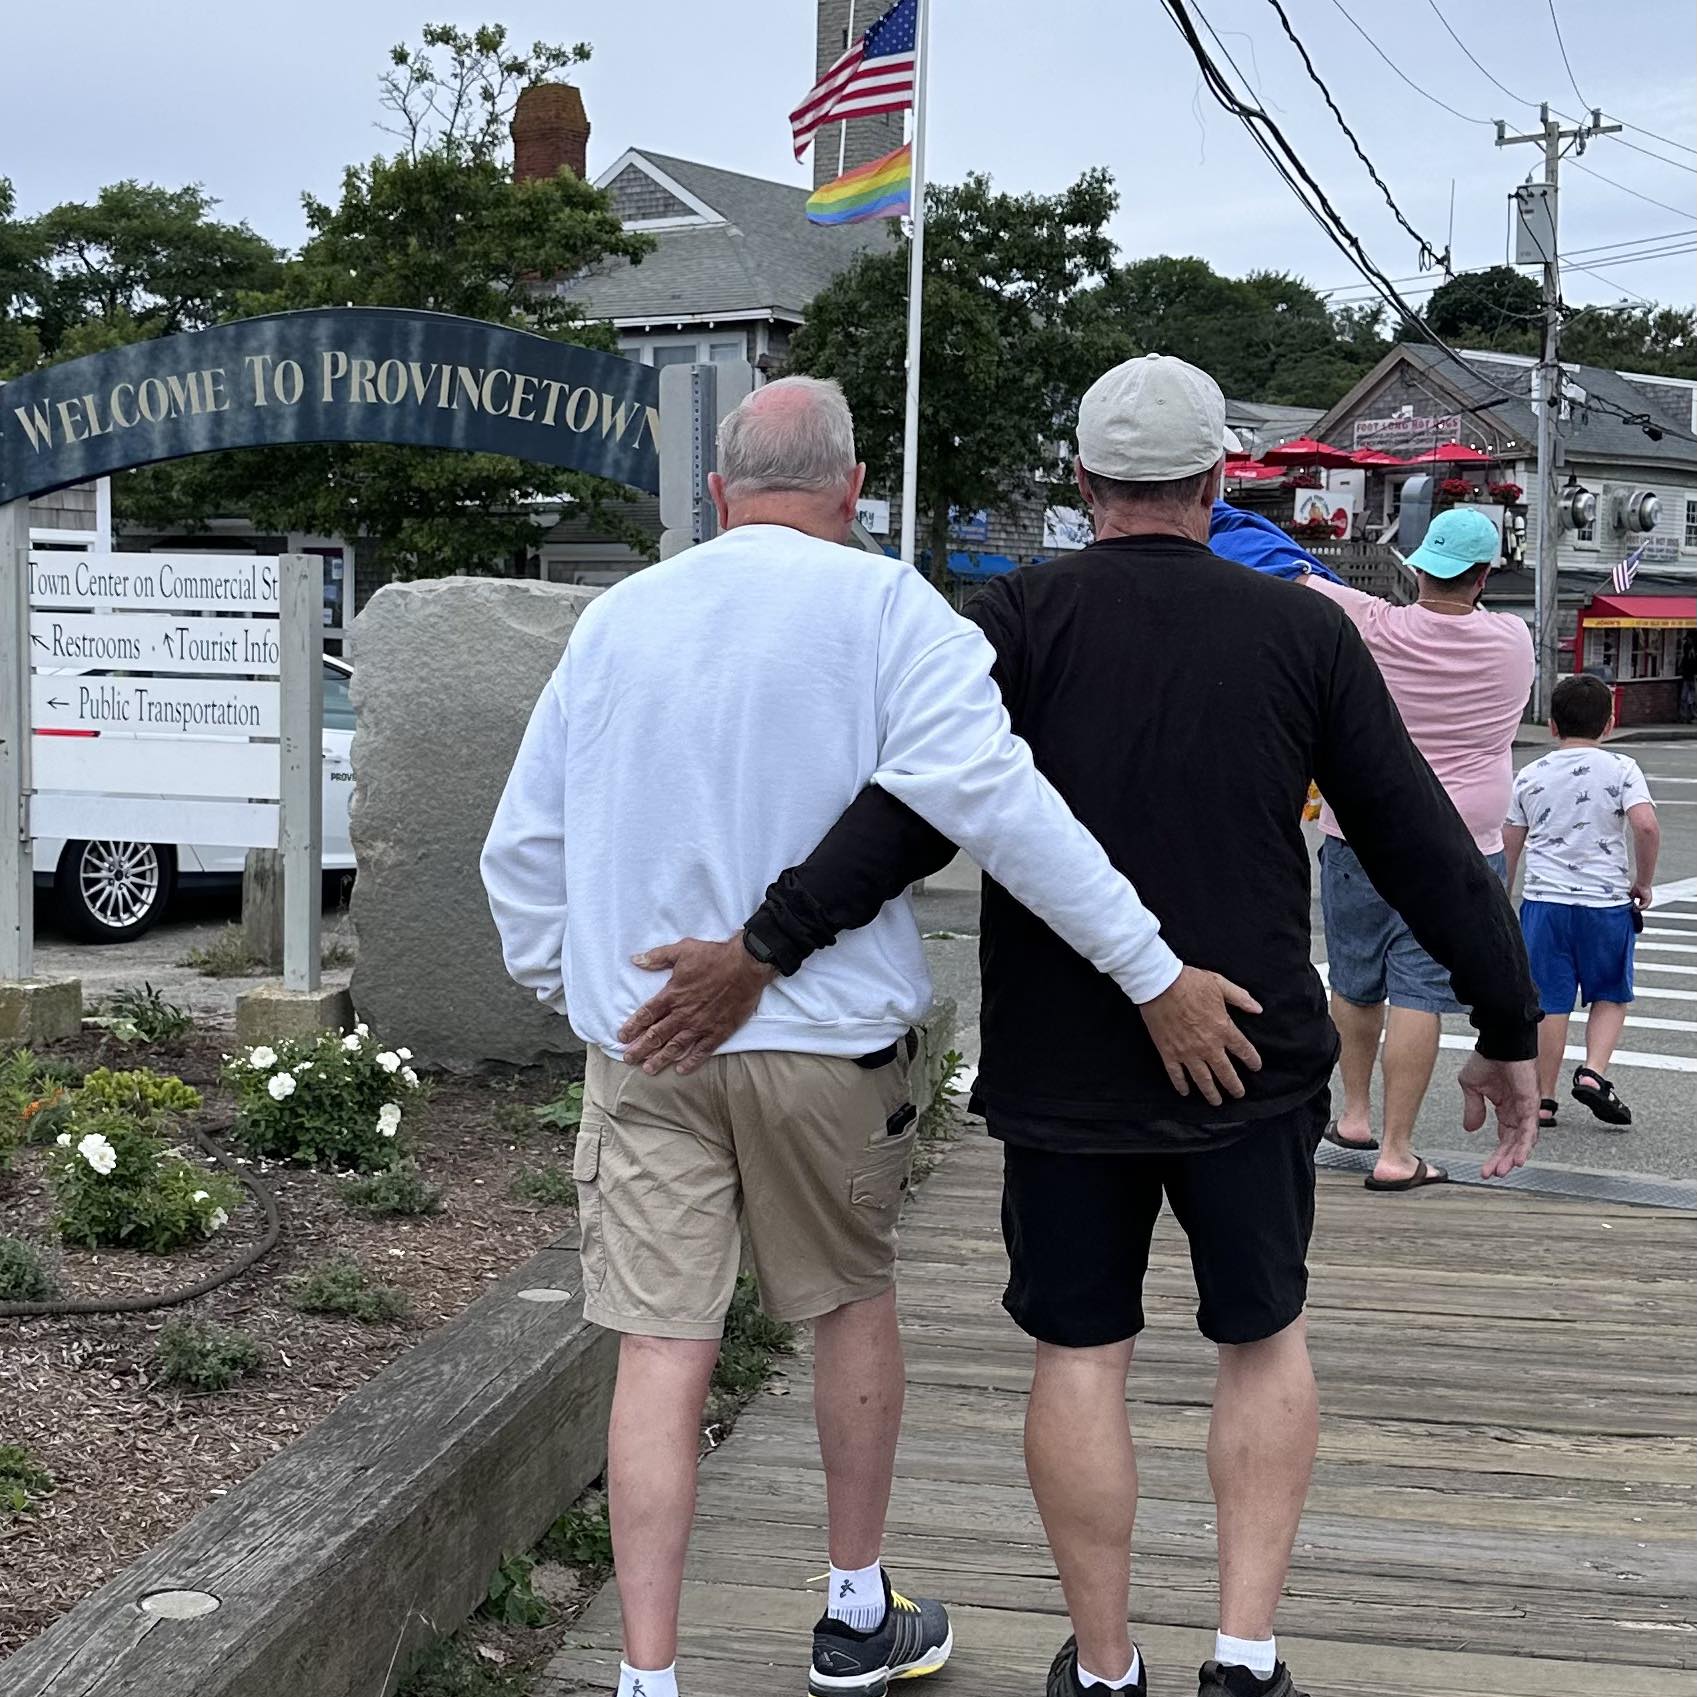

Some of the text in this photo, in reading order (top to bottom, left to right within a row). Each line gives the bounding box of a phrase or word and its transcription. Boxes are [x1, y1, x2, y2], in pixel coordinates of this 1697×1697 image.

[14, 368, 231, 455] WELCOME
[322, 351, 660, 455] PROVINCETOWN
[28, 562, 279, 601] Town Center on Commercial St
[52, 624, 141, 660] Restrooms
[175, 627, 279, 664] Tourist Info
[79, 686, 261, 732] Public Transportation
